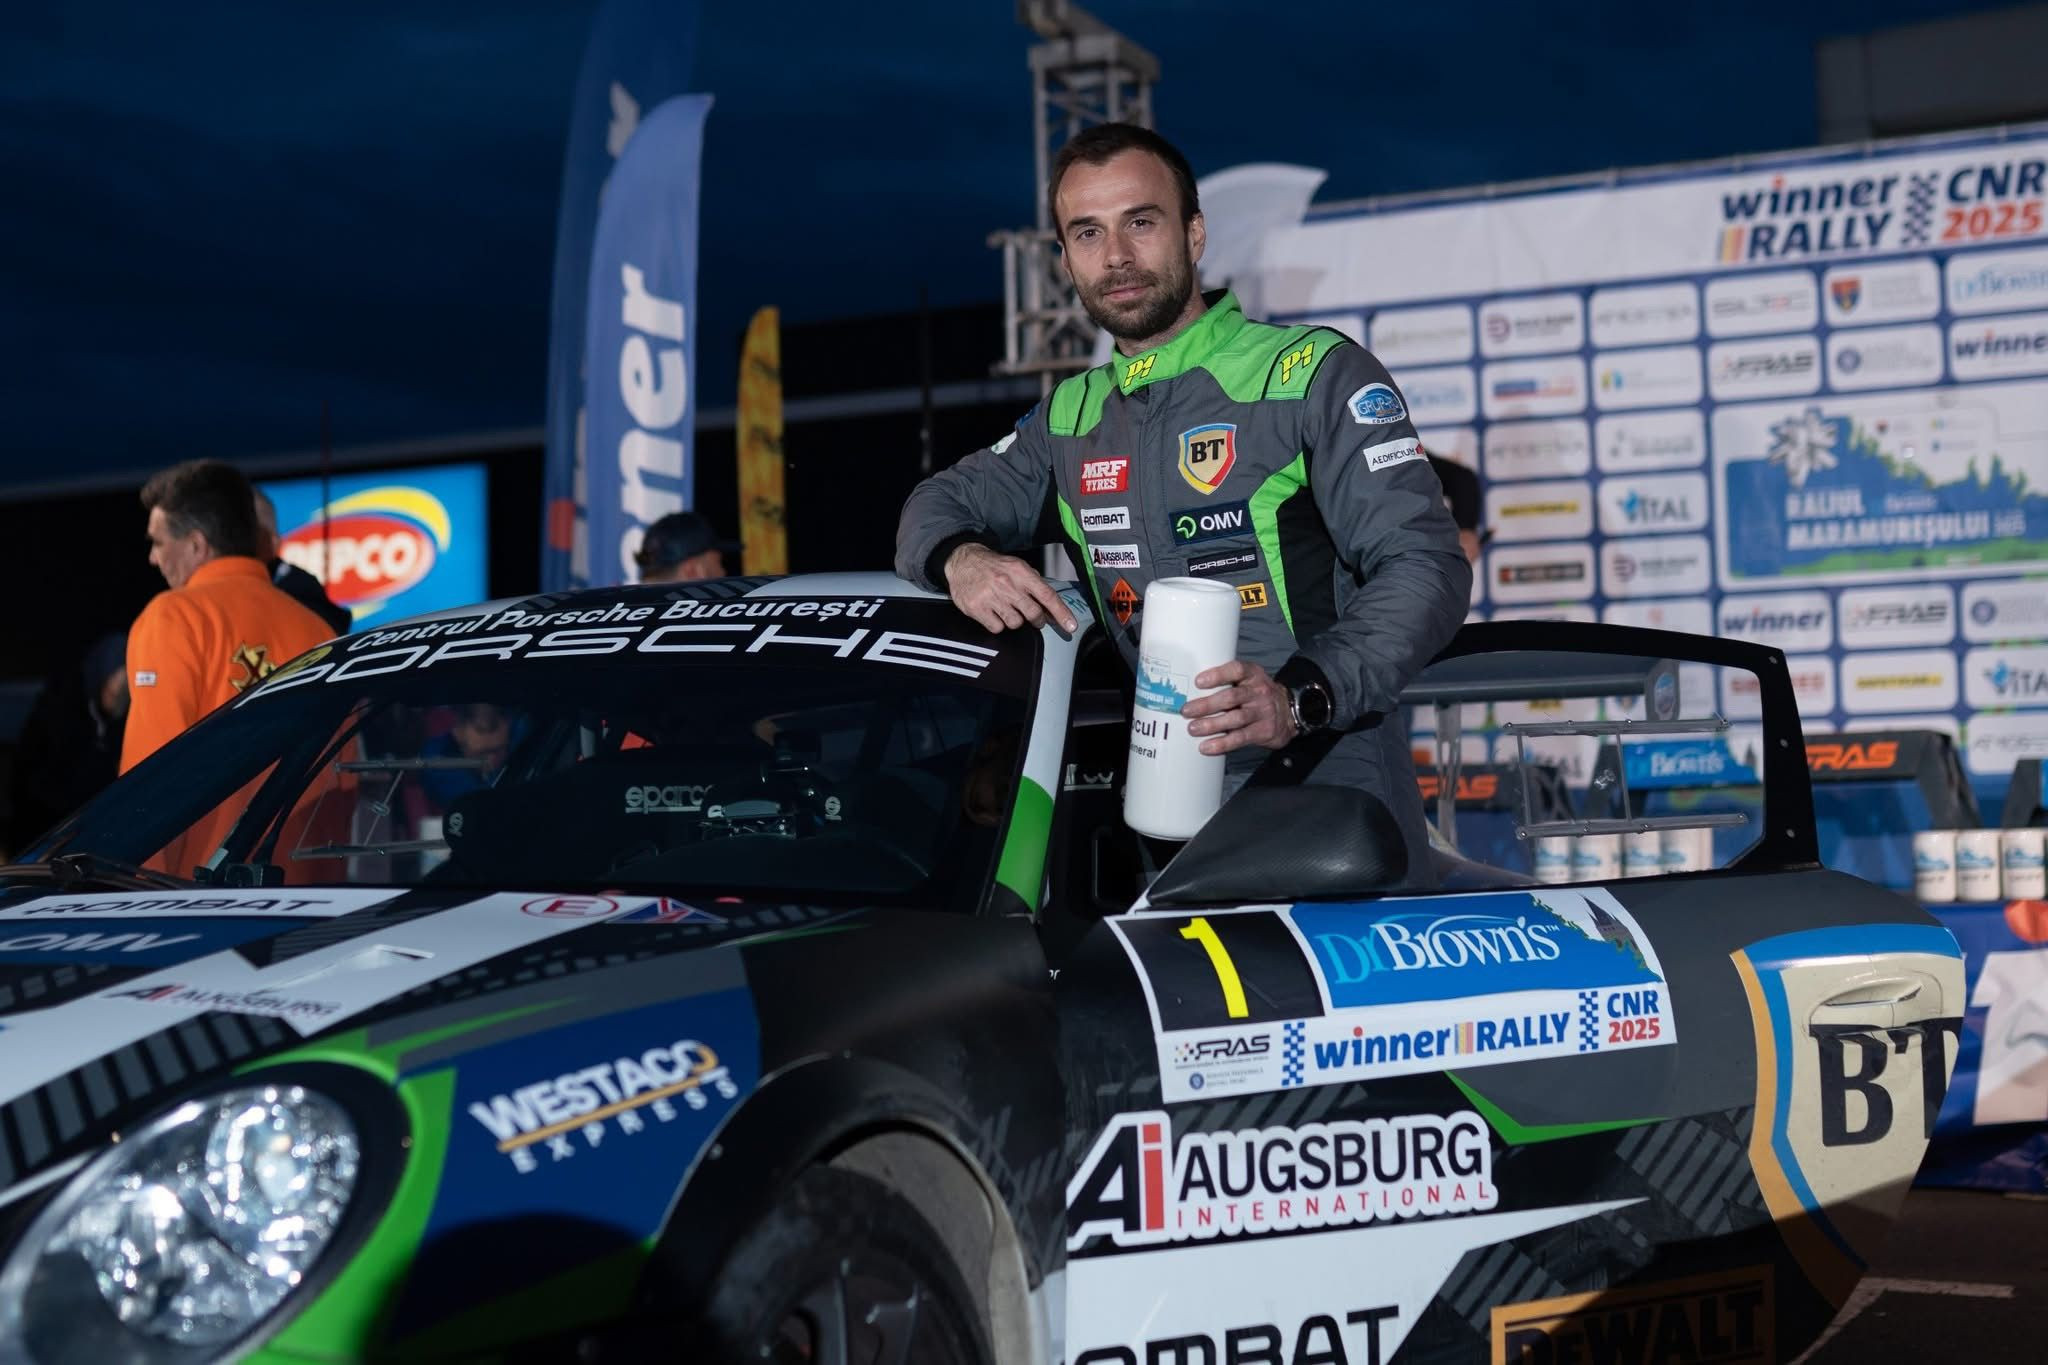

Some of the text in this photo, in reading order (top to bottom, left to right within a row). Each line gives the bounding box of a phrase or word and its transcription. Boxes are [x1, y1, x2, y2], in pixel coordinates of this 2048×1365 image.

[1722, 172, 1899, 222] winner
[1949, 161, 2047, 203] CNR
[1749, 212, 1893, 260] RALLY
[1941, 202, 2045, 242] 2025
[1082, 459, 1127, 479] MRF
[1190, 438, 1225, 464] BT
[1086, 478, 1117, 492] TYRES
[1084, 513, 1125, 526] ROMBAT
[1200, 509, 1243, 531] OMV
[1189, 553, 1256, 572] PORSCHE
[347, 598, 886, 653] Centrul Porsche București
[1724, 607, 1827, 634] winner
[232, 623, 1001, 710] PORSCHE
[23, 898, 334, 916] ROMBAT
[0, 932, 203, 953] OMV
[1178, 916, 1249, 1018] 1
[1606, 989, 1660, 1018] CNR
[1194, 1034, 1270, 1061] FRAS
[1313, 1012, 1571, 1071] winner RALLY
[1608, 1017, 1661, 1043] 2025
[468, 1039, 720, 1142] WESTACO
[1809, 1016, 1965, 1147] BT
[510, 1076, 738, 1173] EXPRESS
[1178, 1122, 1483, 1202] AUGSBURG
[1178, 1180, 1490, 1229] INTERNATIONAL
